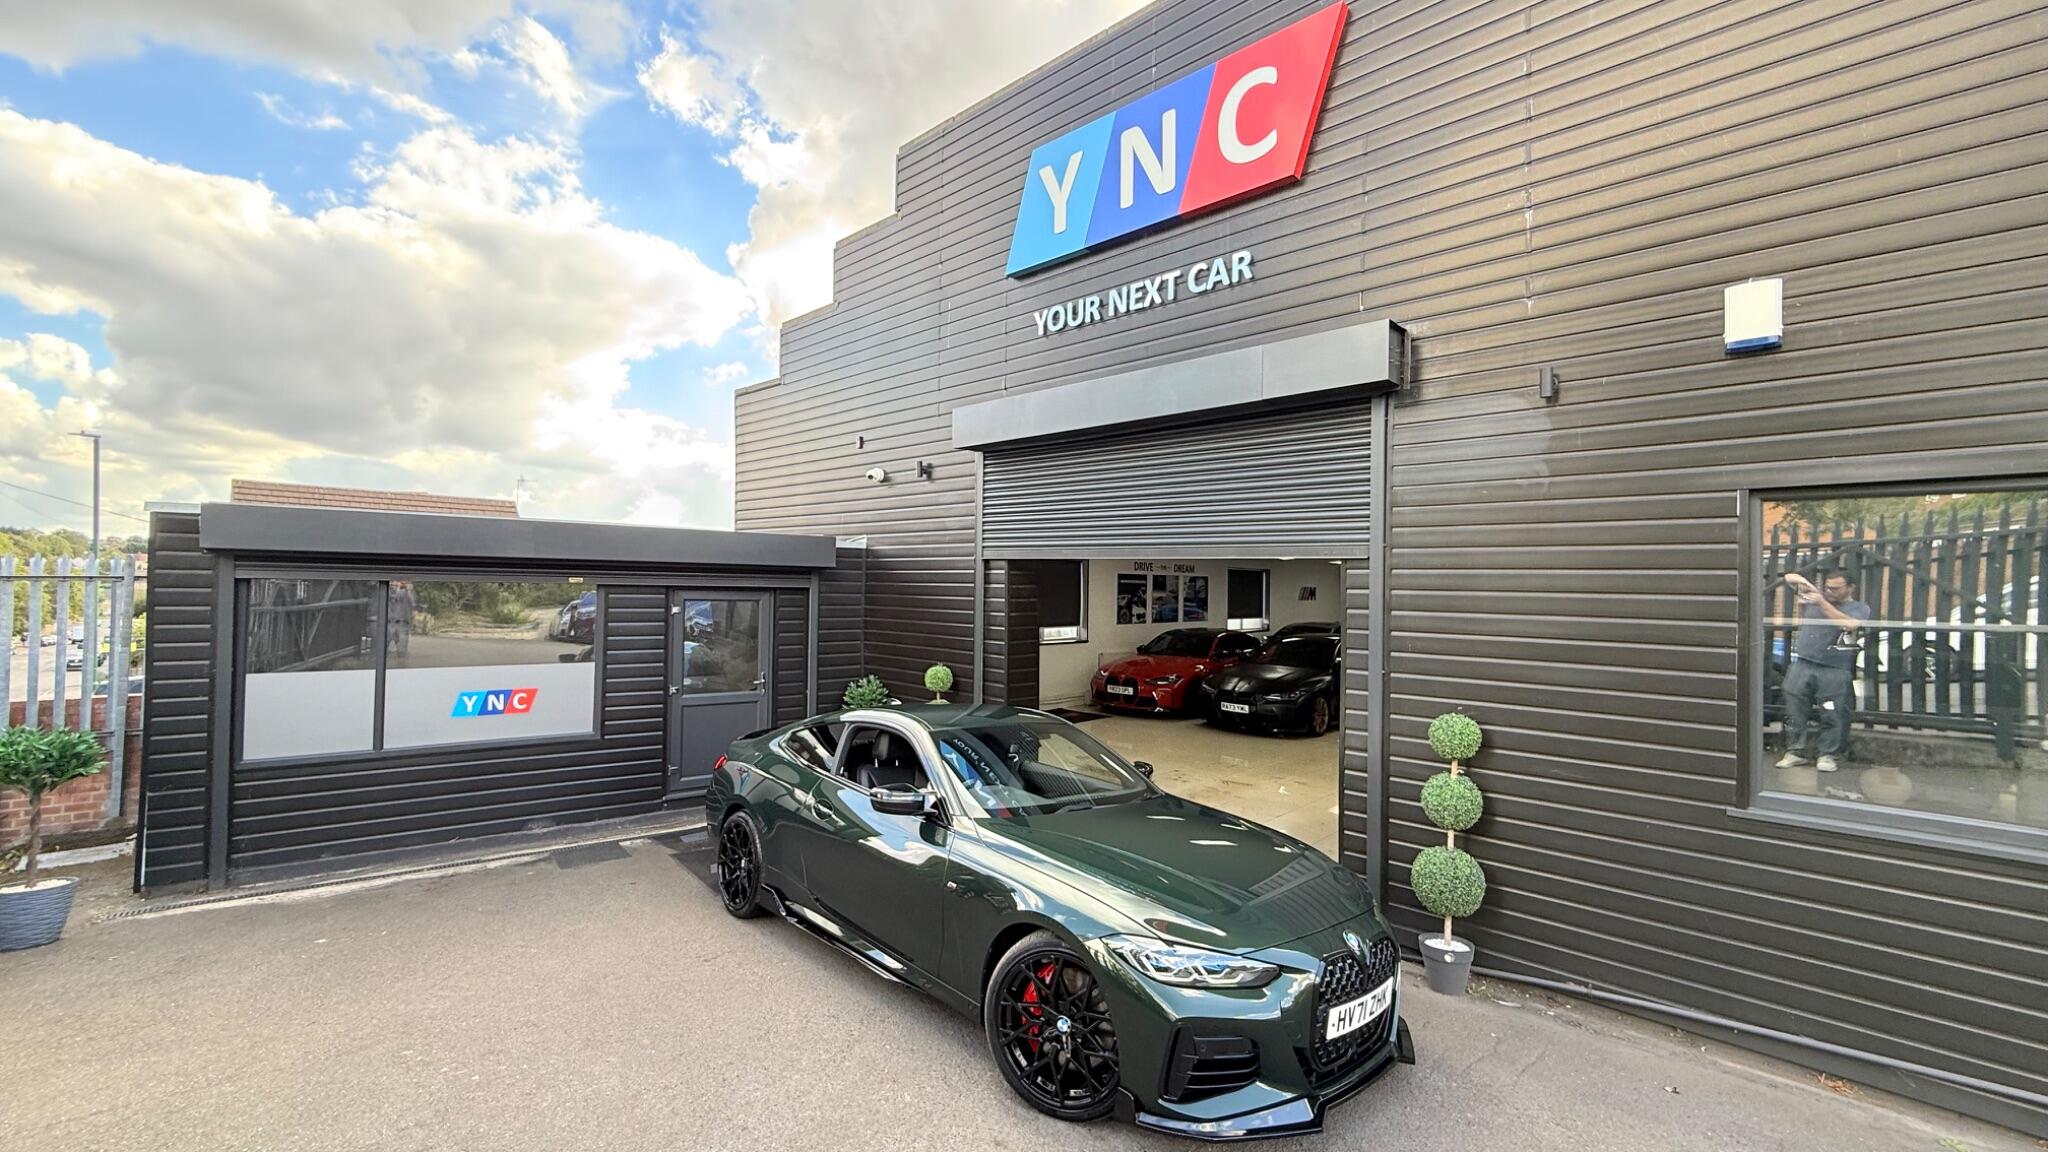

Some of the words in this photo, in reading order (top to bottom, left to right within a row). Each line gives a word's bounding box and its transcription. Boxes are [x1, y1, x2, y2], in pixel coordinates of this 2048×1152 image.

[1039, 66, 1278, 234] YNC
[1033, 295, 1101, 336] YOUR
[1108, 270, 1181, 317] NEXT
[1187, 250, 1254, 294] CAR
[1134, 561, 1154, 572] DRIVE
[1173, 564, 1196, 574] DREAM
[462, 693, 528, 713] YNC
[1337, 999, 1368, 1032] HV71
[1368, 985, 1389, 1017] ZHK
